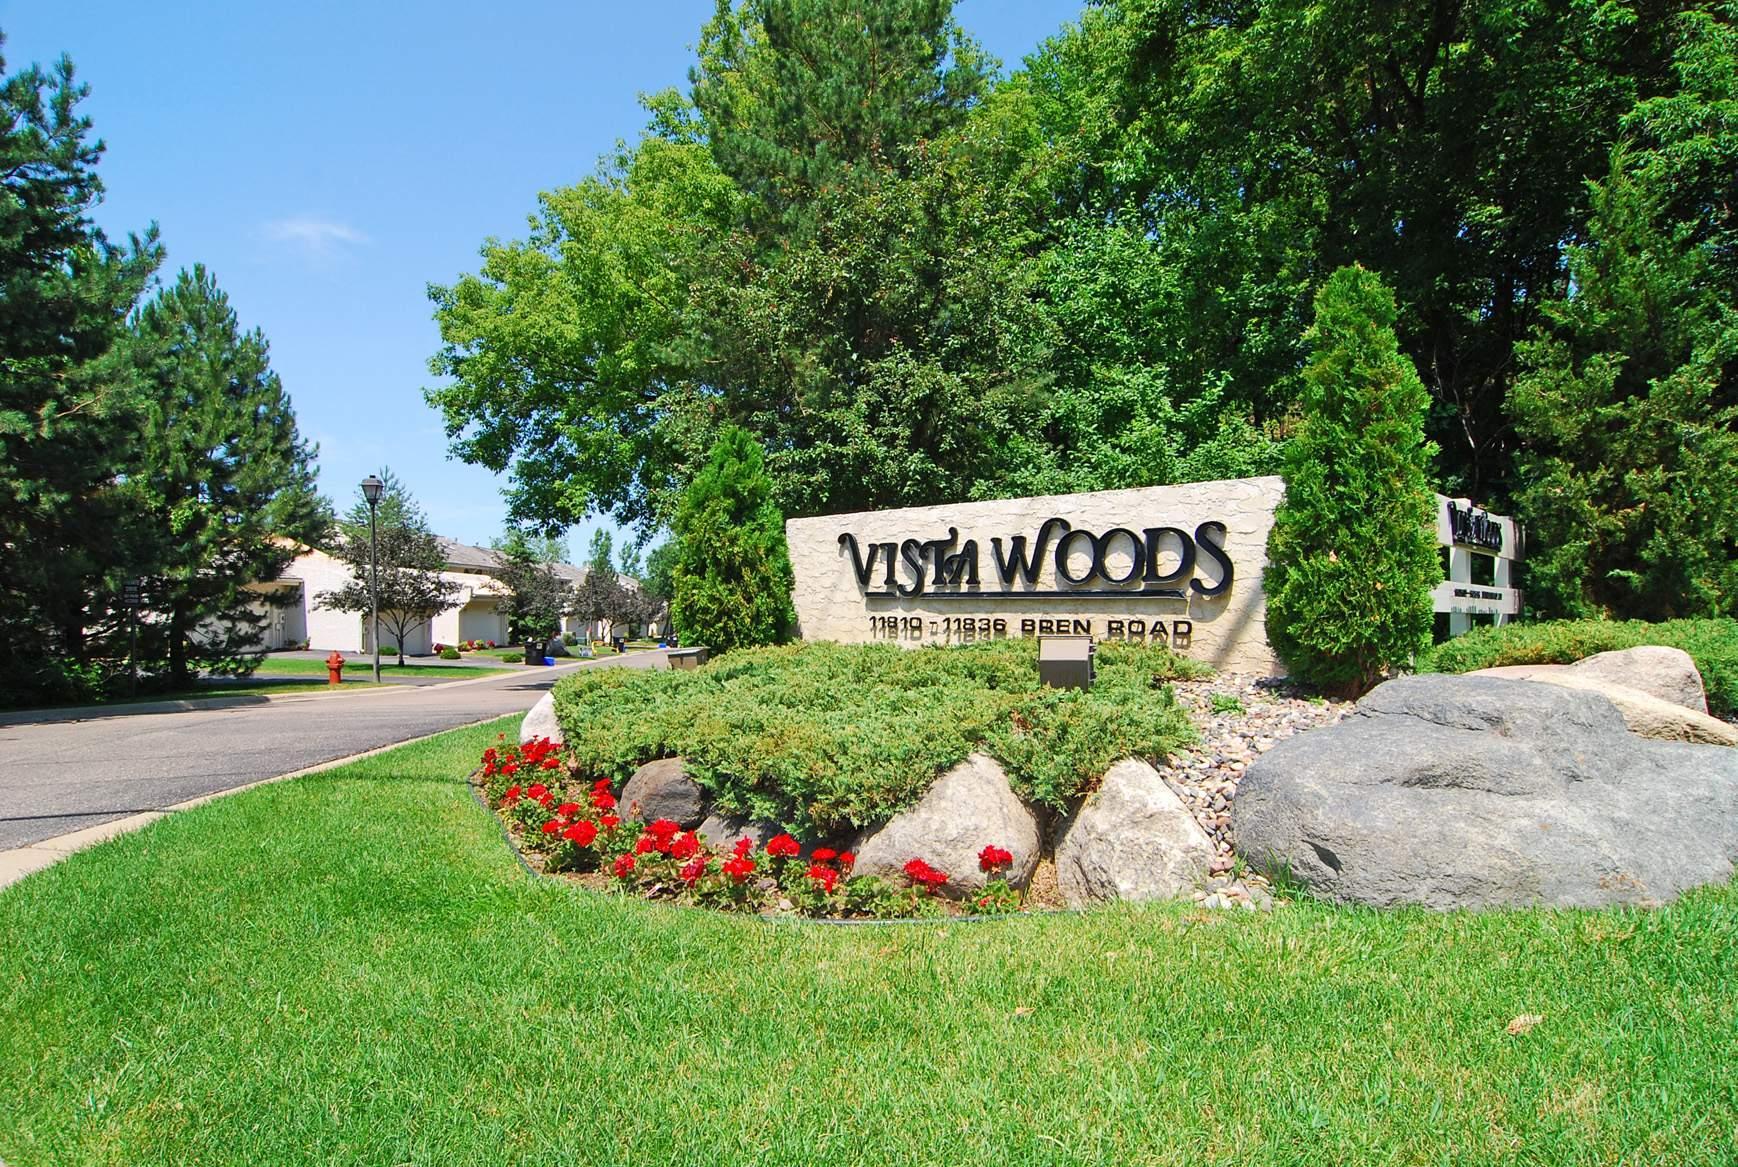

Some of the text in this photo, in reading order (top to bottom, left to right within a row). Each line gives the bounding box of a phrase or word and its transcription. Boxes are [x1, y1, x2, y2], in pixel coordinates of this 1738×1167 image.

[838, 517, 1234, 598] VISTA WOODS
[869, 616, 922, 630] 11810
[942, 617, 1006, 632] 11836
[1021, 619, 1091, 634] BREN
[1108, 620, 1193, 636] ROAD
